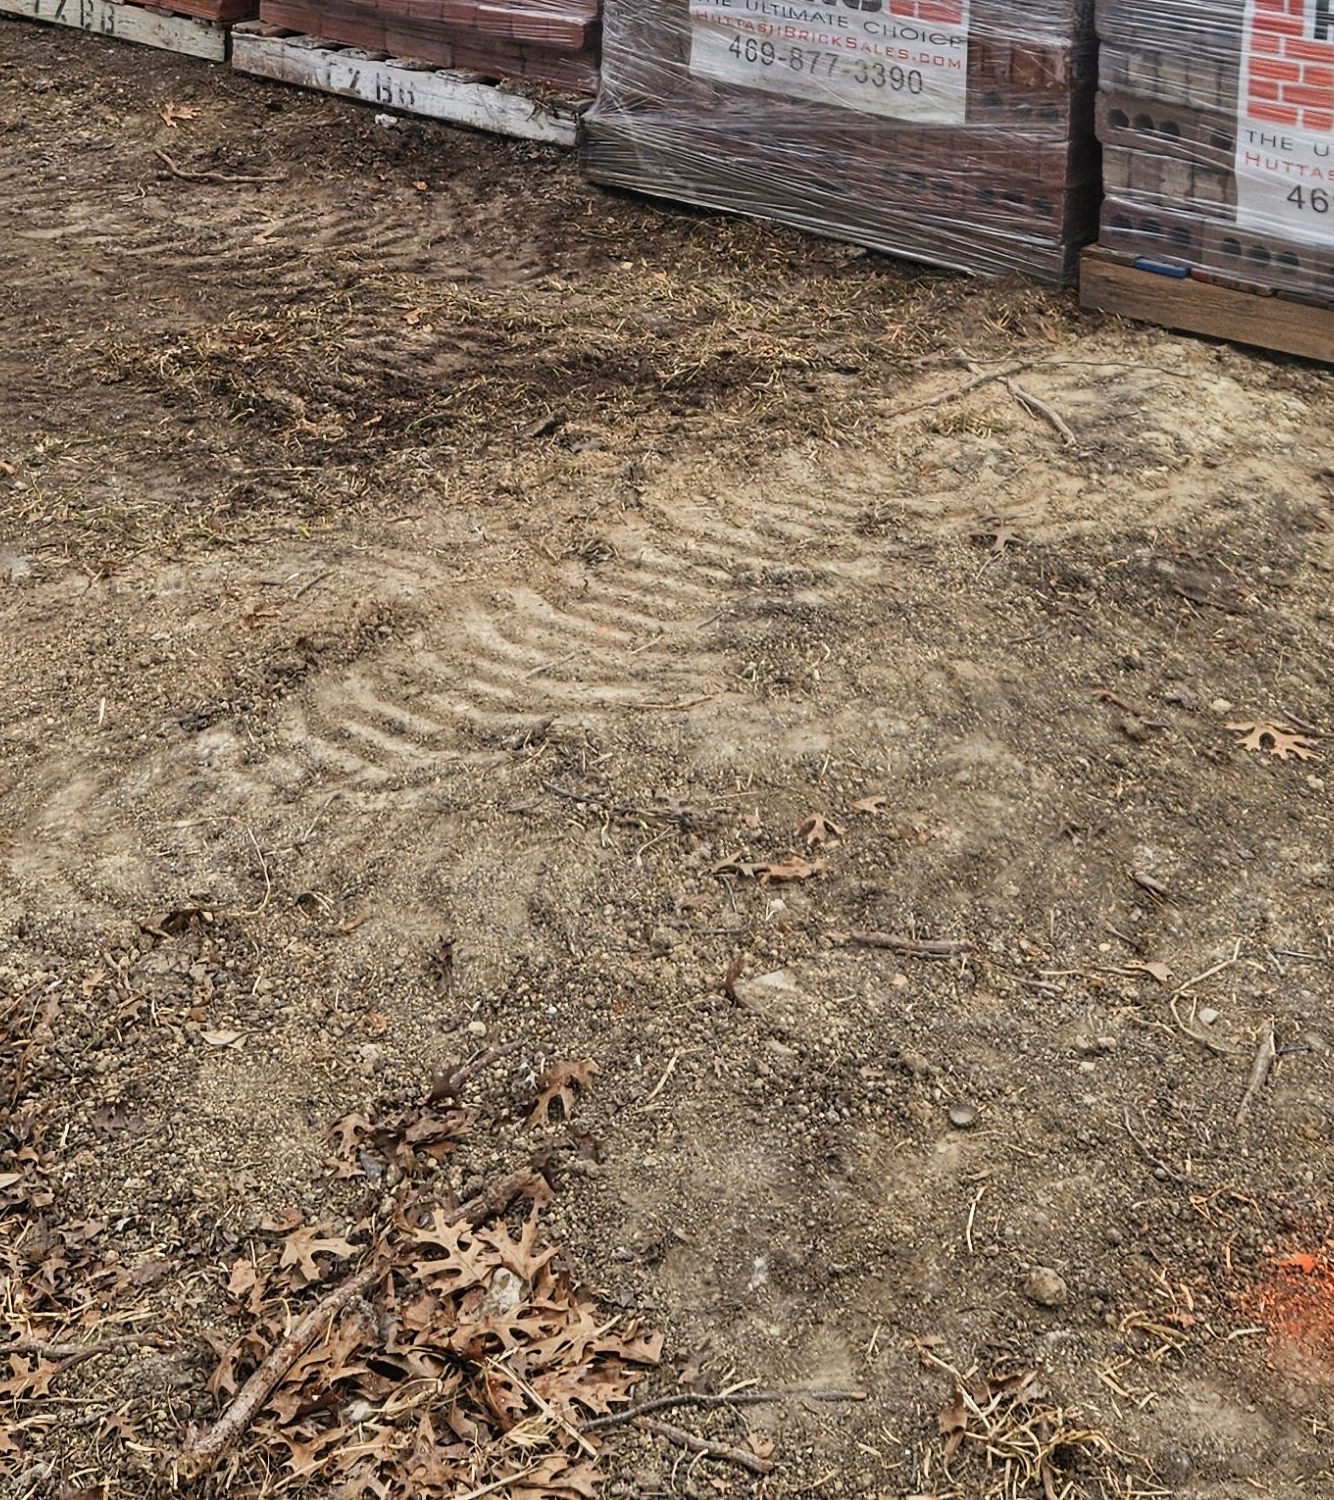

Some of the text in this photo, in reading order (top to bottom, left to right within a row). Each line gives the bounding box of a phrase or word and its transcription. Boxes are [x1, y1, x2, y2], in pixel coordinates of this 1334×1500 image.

[746, 0, 849, 29] ULTIMATE
[863, 21, 965, 49] CHOICE
[729, 35, 923, 95] 469-877-3390
[1245, 130, 1295, 152] THE
